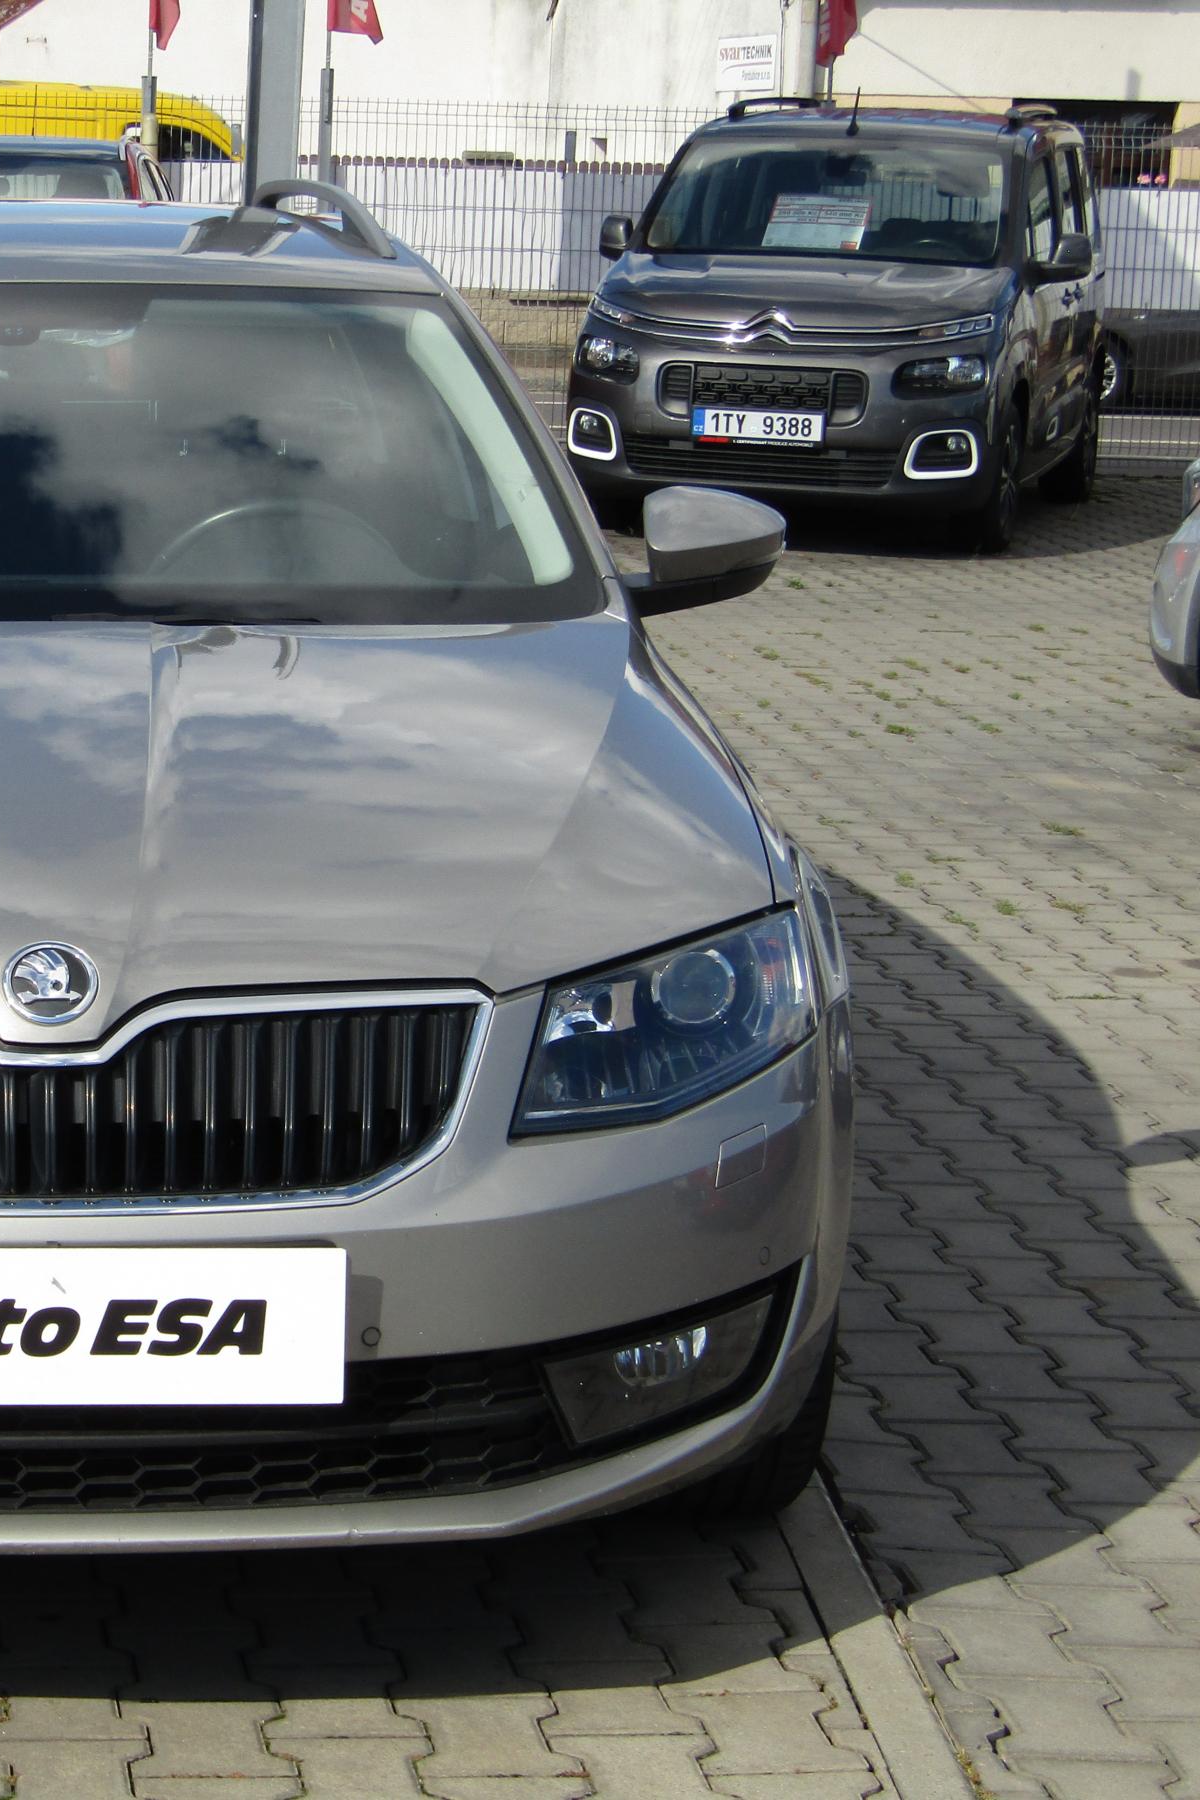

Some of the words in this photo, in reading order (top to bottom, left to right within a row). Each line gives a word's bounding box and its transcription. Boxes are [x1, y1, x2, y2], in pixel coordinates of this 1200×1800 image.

[711, 413, 746, 434] 1TY
[762, 416, 812, 437] 9388
[90, 1297, 268, 1357] ESA
